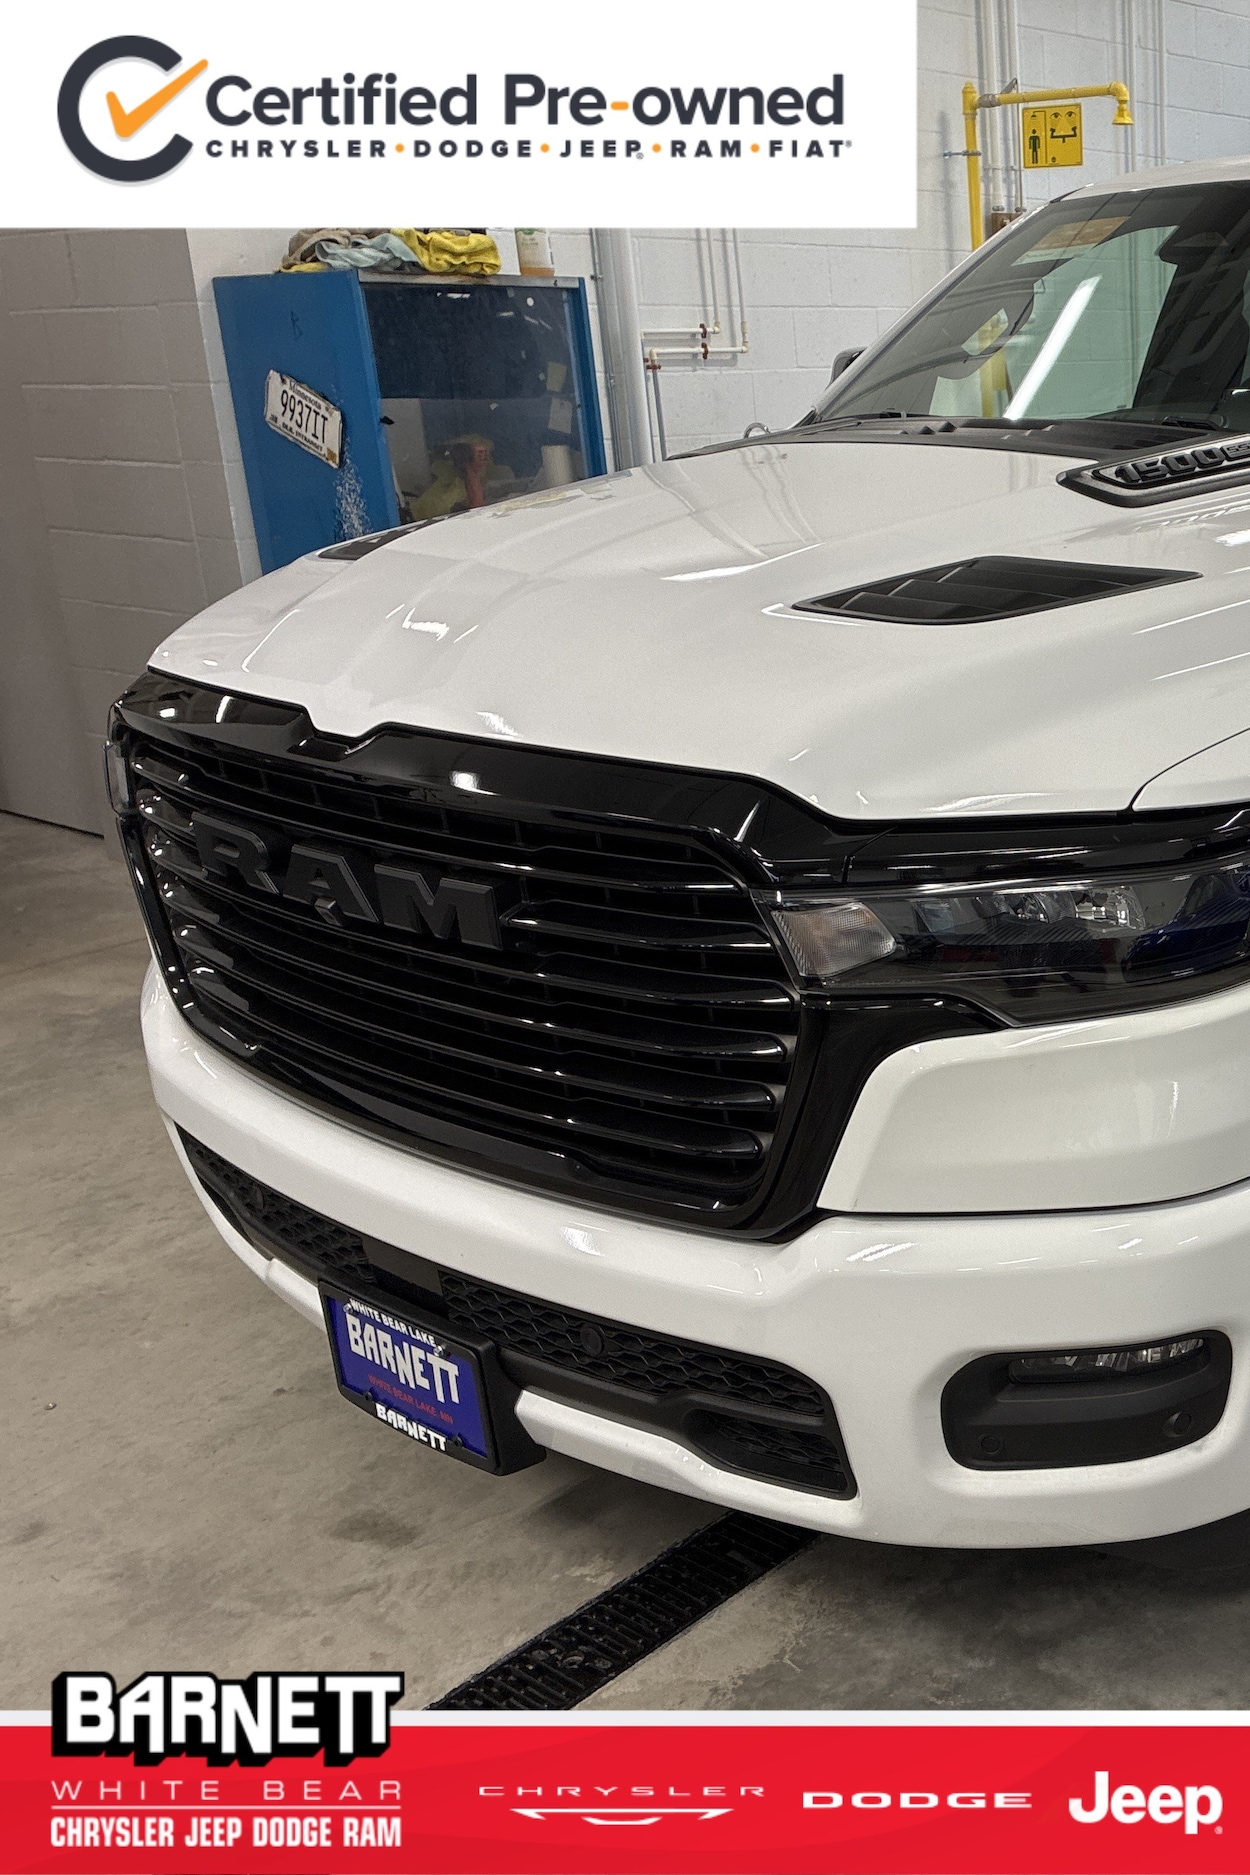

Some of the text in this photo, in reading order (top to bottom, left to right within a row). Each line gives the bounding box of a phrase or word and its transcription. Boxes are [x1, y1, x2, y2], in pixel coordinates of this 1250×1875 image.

[1115, 448, 1225, 484] 1500
[192, 810, 502, 950] RAM
[349, 1298, 436, 1348] WHITE BEAR LAKE
[346, 1314, 460, 1404] BARNETT
[368, 1374, 392, 1396] WHITE
[393, 1385, 415, 1405] BEAR
[375, 1403, 447, 1452] BARNETT
